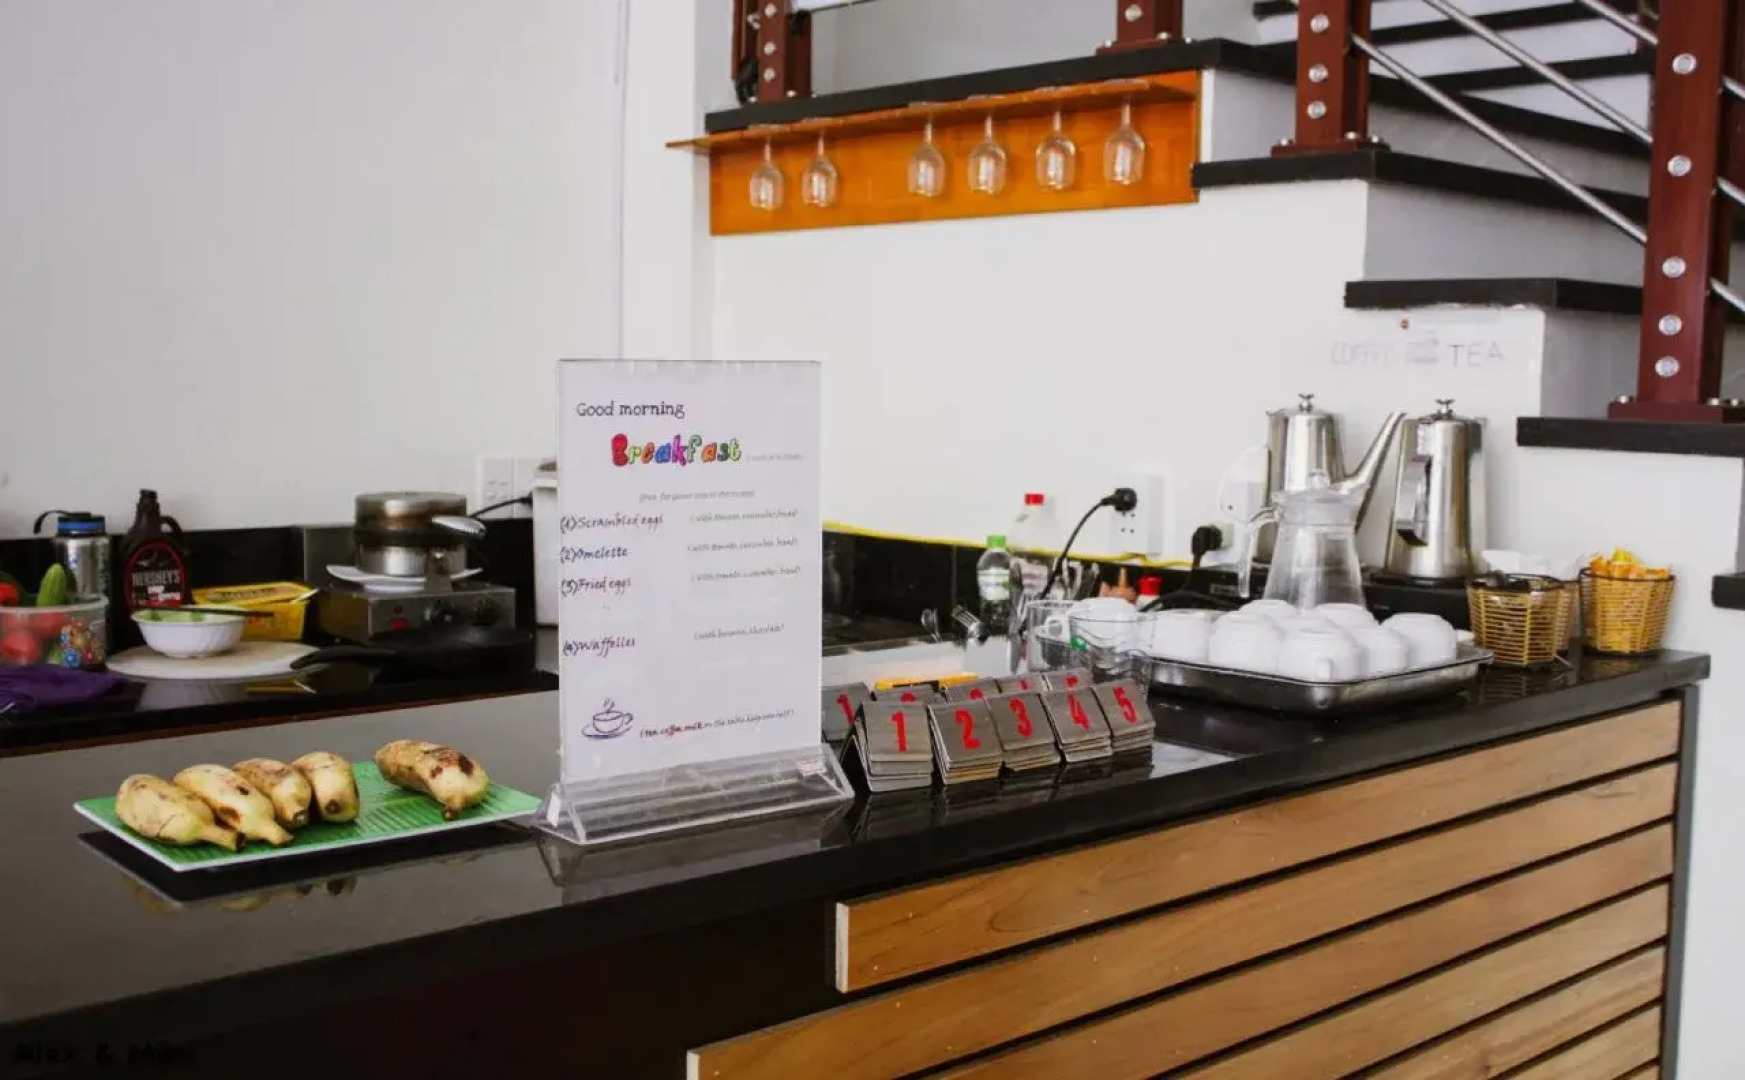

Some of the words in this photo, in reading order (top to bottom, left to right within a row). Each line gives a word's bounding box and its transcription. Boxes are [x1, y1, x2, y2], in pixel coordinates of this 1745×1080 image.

[1446, 341, 1503, 367] TEA
[576, 399, 614, 417] Good
[619, 400, 685, 419] morning
[610, 433, 742, 467] Breakfast
[131, 570, 181, 586] HERSHEY'S
[836, 692, 855, 726] 1
[1009, 697, 1034, 739] 3
[1068, 692, 1090, 730] 4
[1112, 686, 1138, 724] 5
[890, 710, 907, 753] 1
[954, 708, 982, 750] 2
